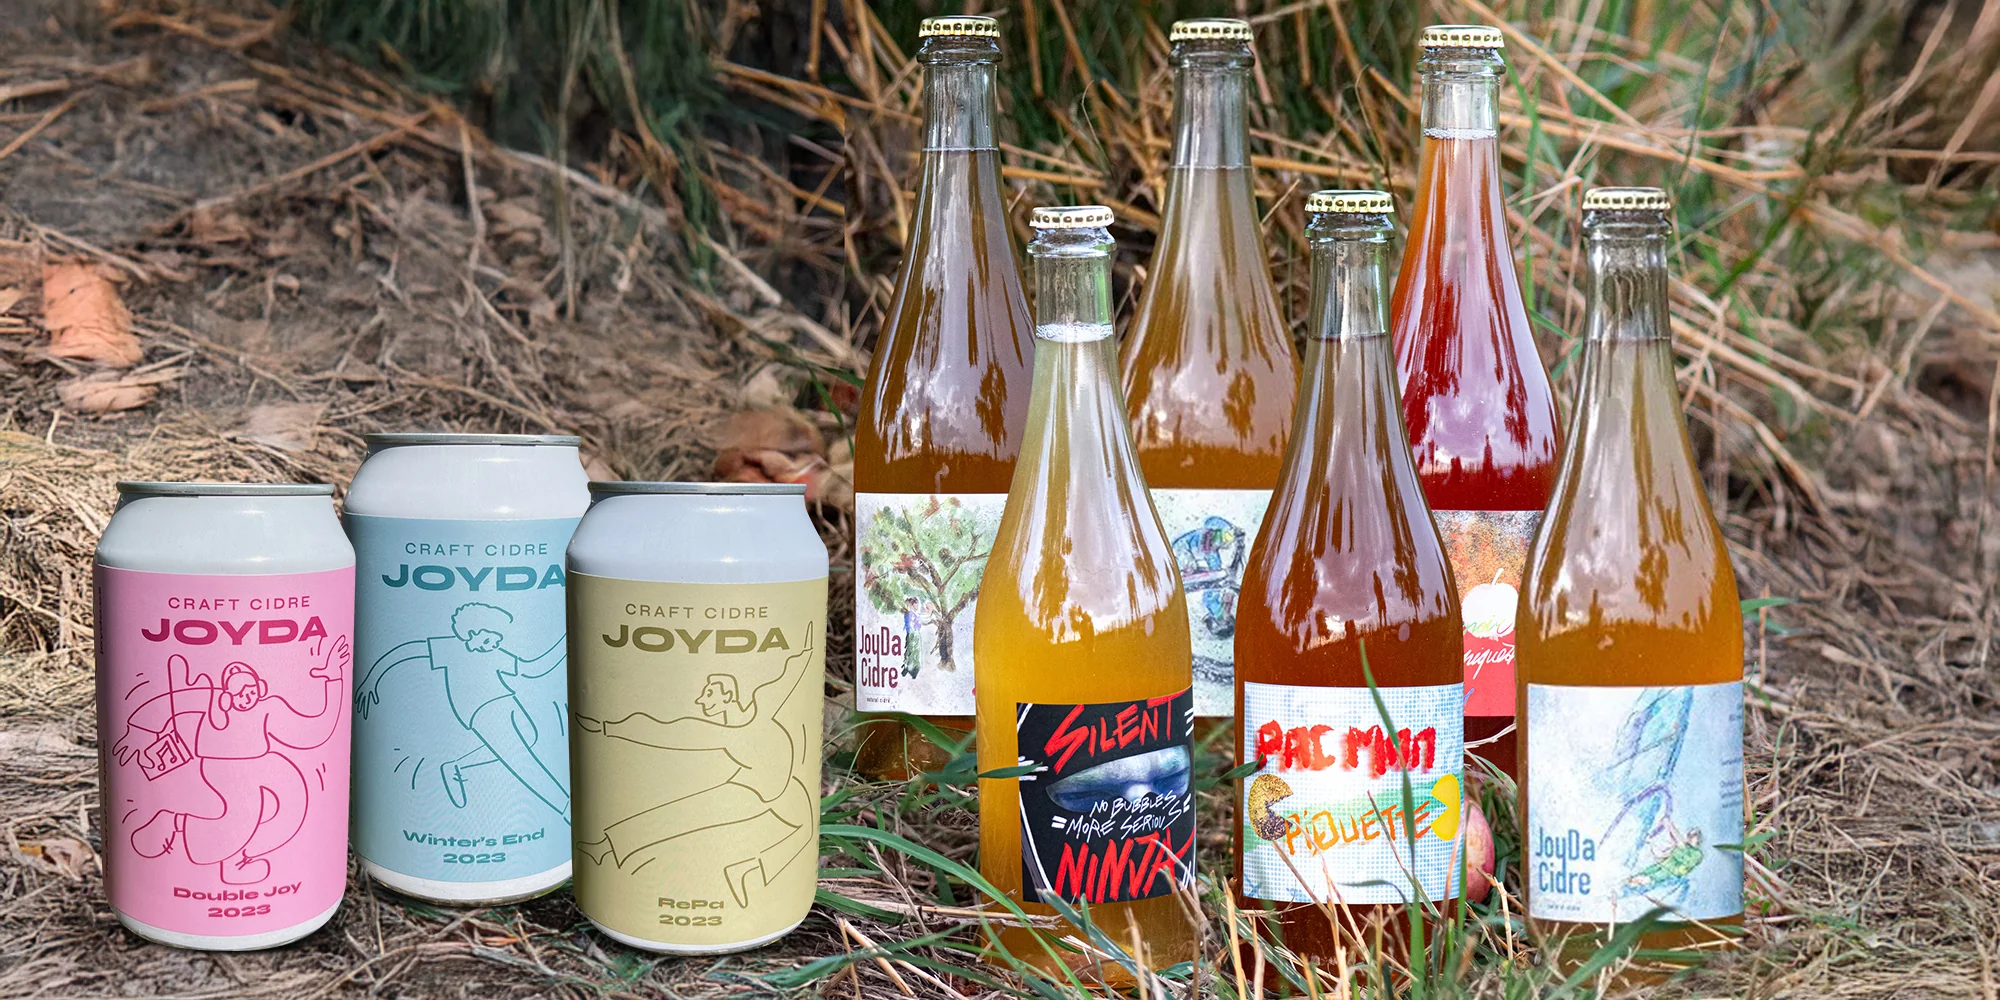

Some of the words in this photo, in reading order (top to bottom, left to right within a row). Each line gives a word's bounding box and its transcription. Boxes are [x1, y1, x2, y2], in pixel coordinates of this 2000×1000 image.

[405, 542, 475, 557] CRAFT
[485, 543, 548, 557] CIDRE
[381, 564, 566, 592] JOYDA
[168, 597, 240, 611] CRAFT
[250, 595, 310, 610] CIDRE
[625, 603, 694, 619] CRAFT
[704, 606, 768, 620] CIDRE
[141, 616, 328, 646] JOYDA
[602, 624, 790, 654] JOYDA
[859, 625, 902, 657] JoyDa
[861, 657, 899, 689] Cidre
[1044, 690, 1187, 774] SILENT
[1254, 720, 1337, 772] PAC
[1089, 801, 1109, 817] NO
[1110, 789, 1177, 820] BUBBLES
[403, 829, 498, 848] Winter's
[502, 827, 545, 846] End
[1065, 815, 1116, 843] MORE
[443, 852, 506, 864] 2023
[1535, 826, 1595, 862] JoyDa
[1053, 825, 1195, 904] NINJA
[1538, 861, 1591, 895] Cidre
[173, 886, 259, 901] Double
[263, 881, 302, 898] Joy
[658, 897, 724, 910] RePa
[208, 904, 271, 918] 2023
[659, 914, 722, 926] 2023
